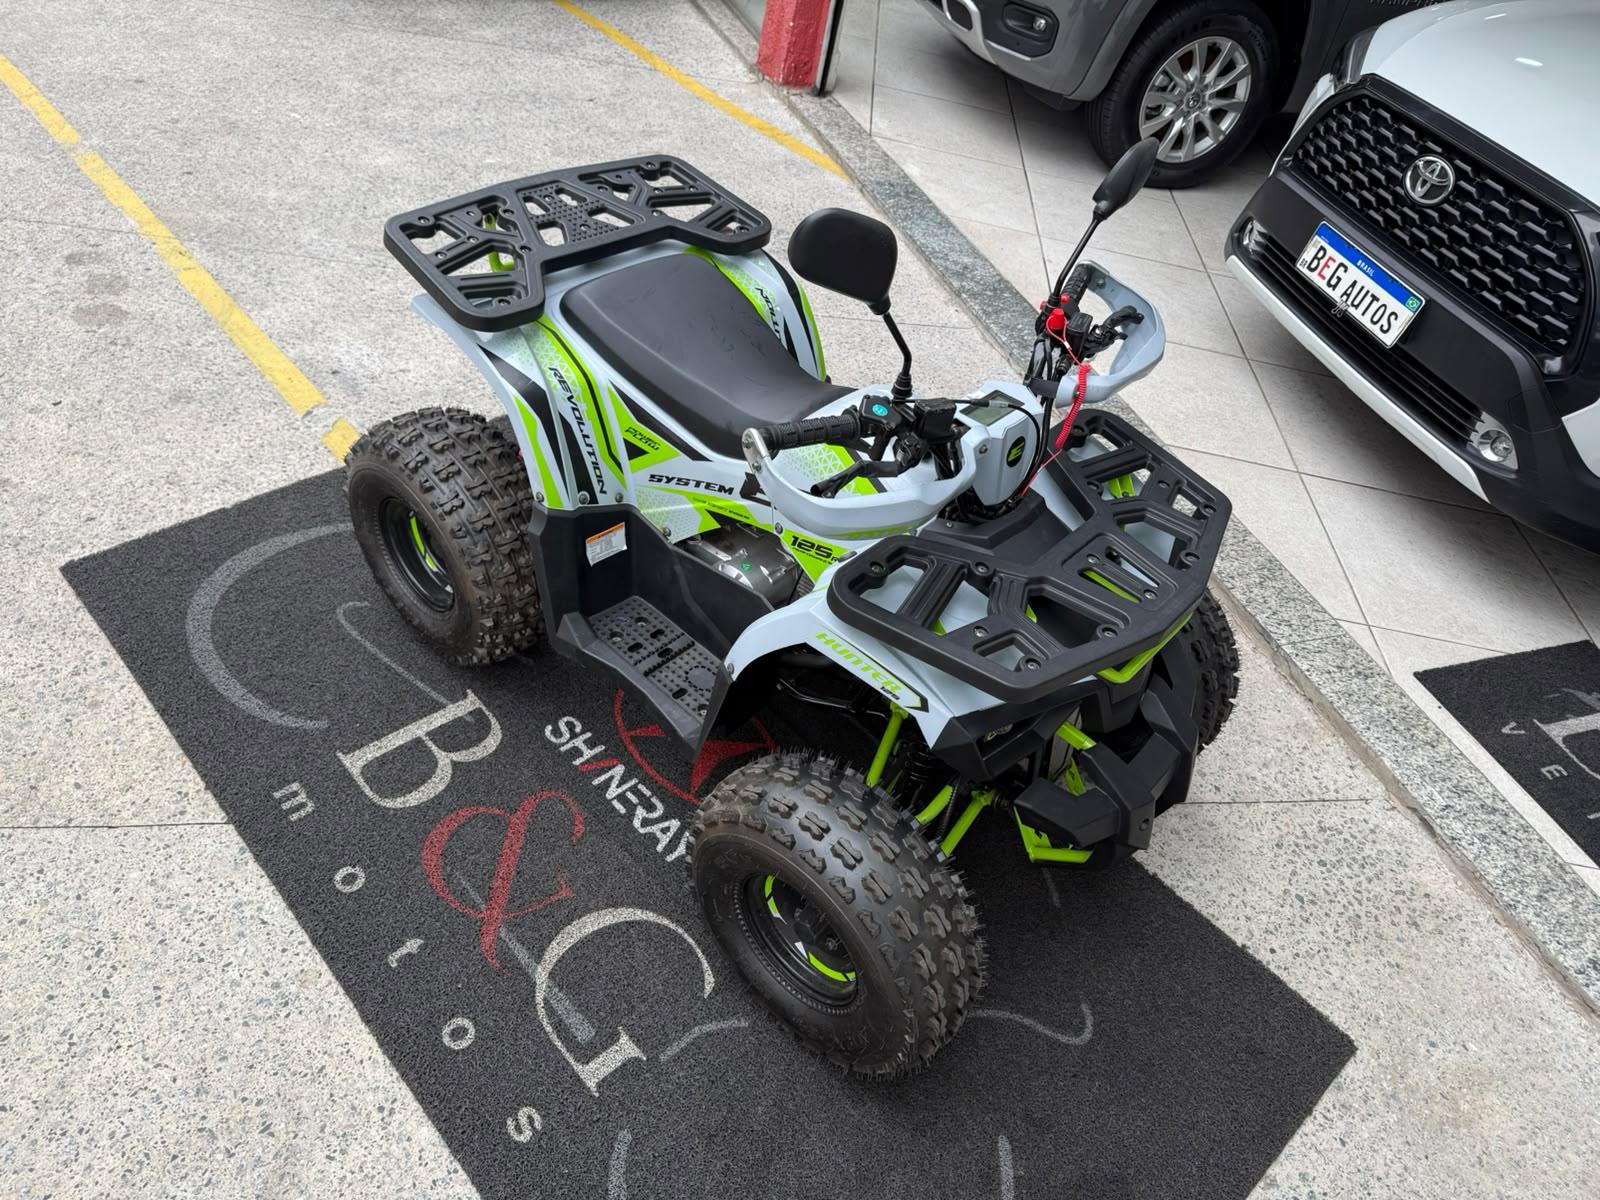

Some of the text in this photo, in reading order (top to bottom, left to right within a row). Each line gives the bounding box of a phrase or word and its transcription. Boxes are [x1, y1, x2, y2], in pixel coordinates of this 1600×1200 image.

[1307, 245, 1398, 334] BEG AUTOS
[1357, 260, 1376, 277] BRASIL
[549, 367, 607, 494] REVOLUTION
[648, 474, 734, 495] SYSTEM
[815, 631, 902, 692] HUNTER
